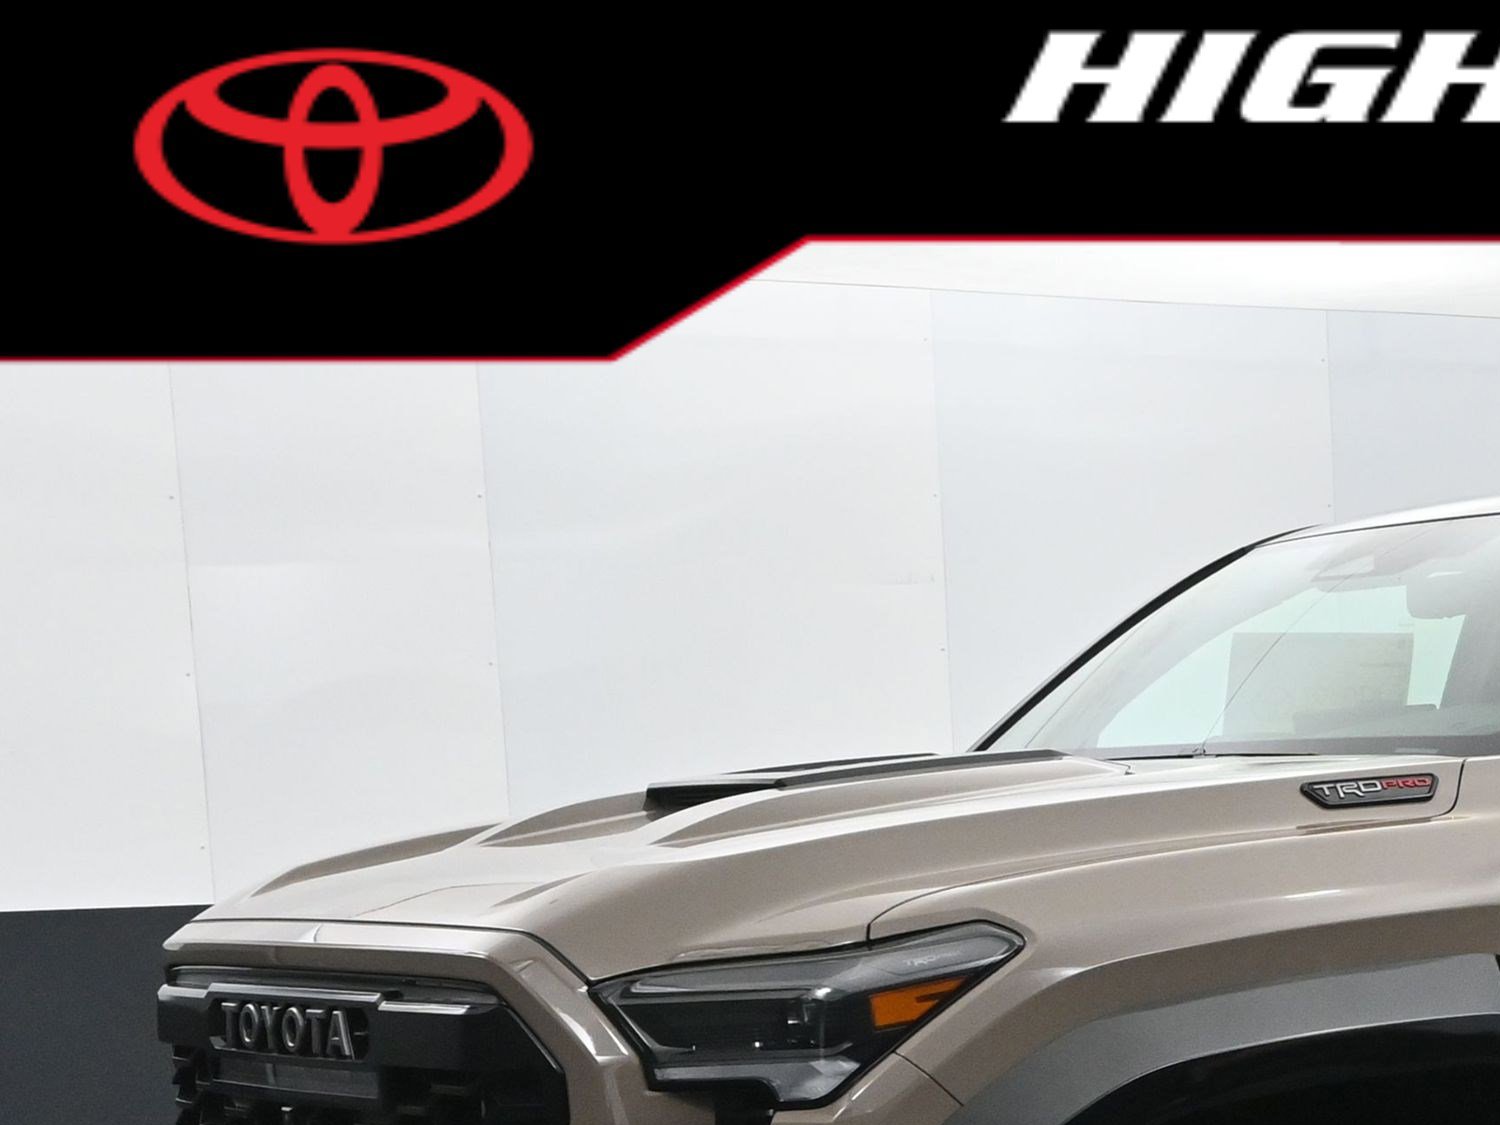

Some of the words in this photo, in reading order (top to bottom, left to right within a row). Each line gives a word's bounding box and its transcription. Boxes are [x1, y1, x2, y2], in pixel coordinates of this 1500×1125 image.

[1313, 780, 1382, 798] TRD
[1382, 777, 1431, 790] PRO
[220, 1002, 352, 1058] TOYOTA
